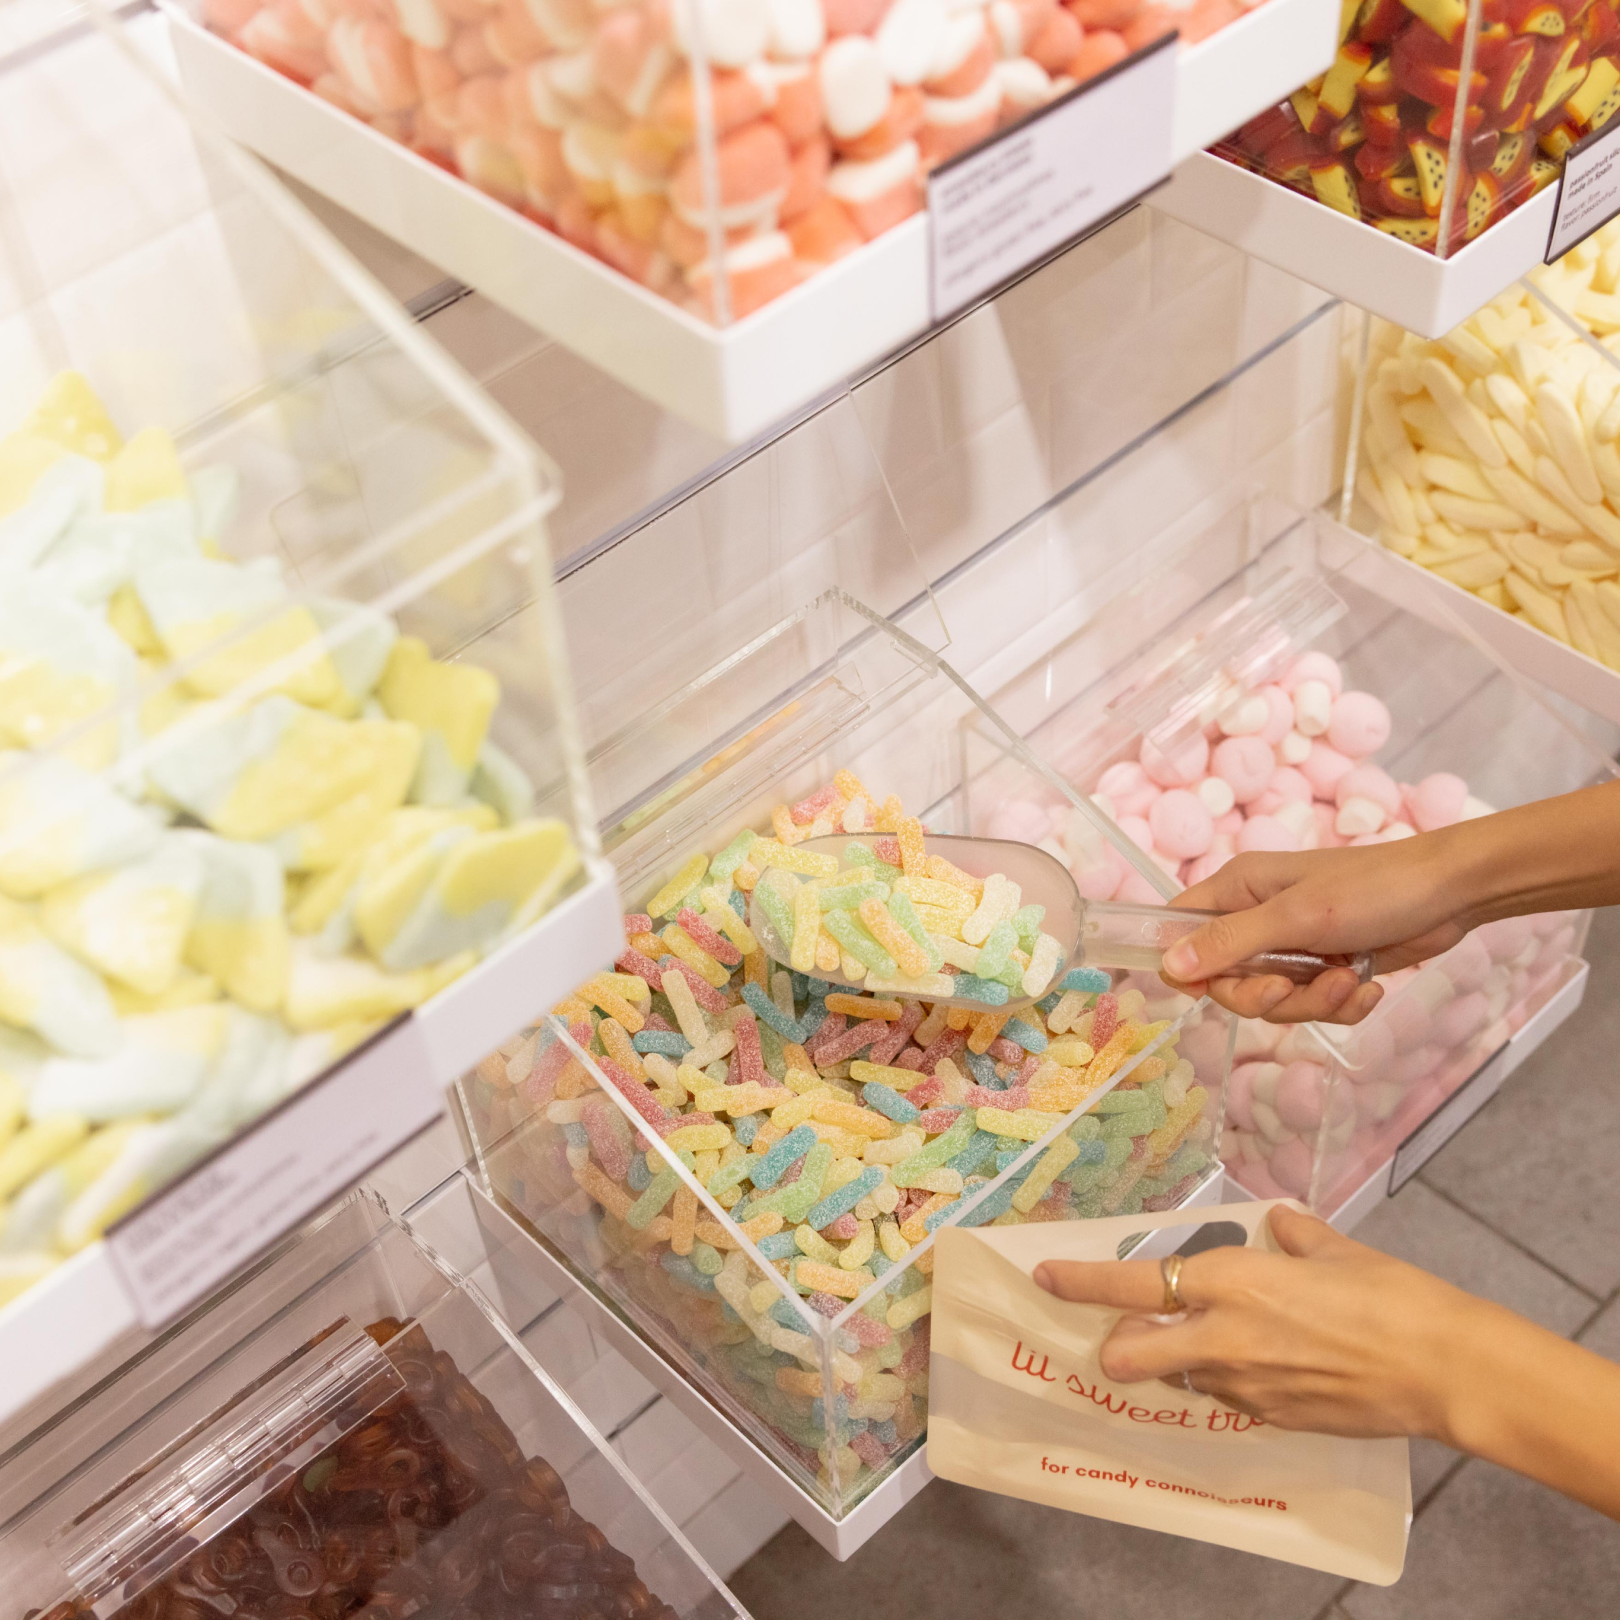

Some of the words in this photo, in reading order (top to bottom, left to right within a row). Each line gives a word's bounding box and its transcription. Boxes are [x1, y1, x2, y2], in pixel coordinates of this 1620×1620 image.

[1568, 182, 1586, 199] made
[1587, 177, 1594, 187] in
[1595, 163, 1613, 181] Spain
[1011, 1341, 1057, 1382] lil
[1066, 1373, 1197, 1428] sweet
[1041, 1456, 1070, 1474] for
[1075, 1467, 1139, 1489] candy
[1145, 1478, 1288, 1511] connoisseurs
